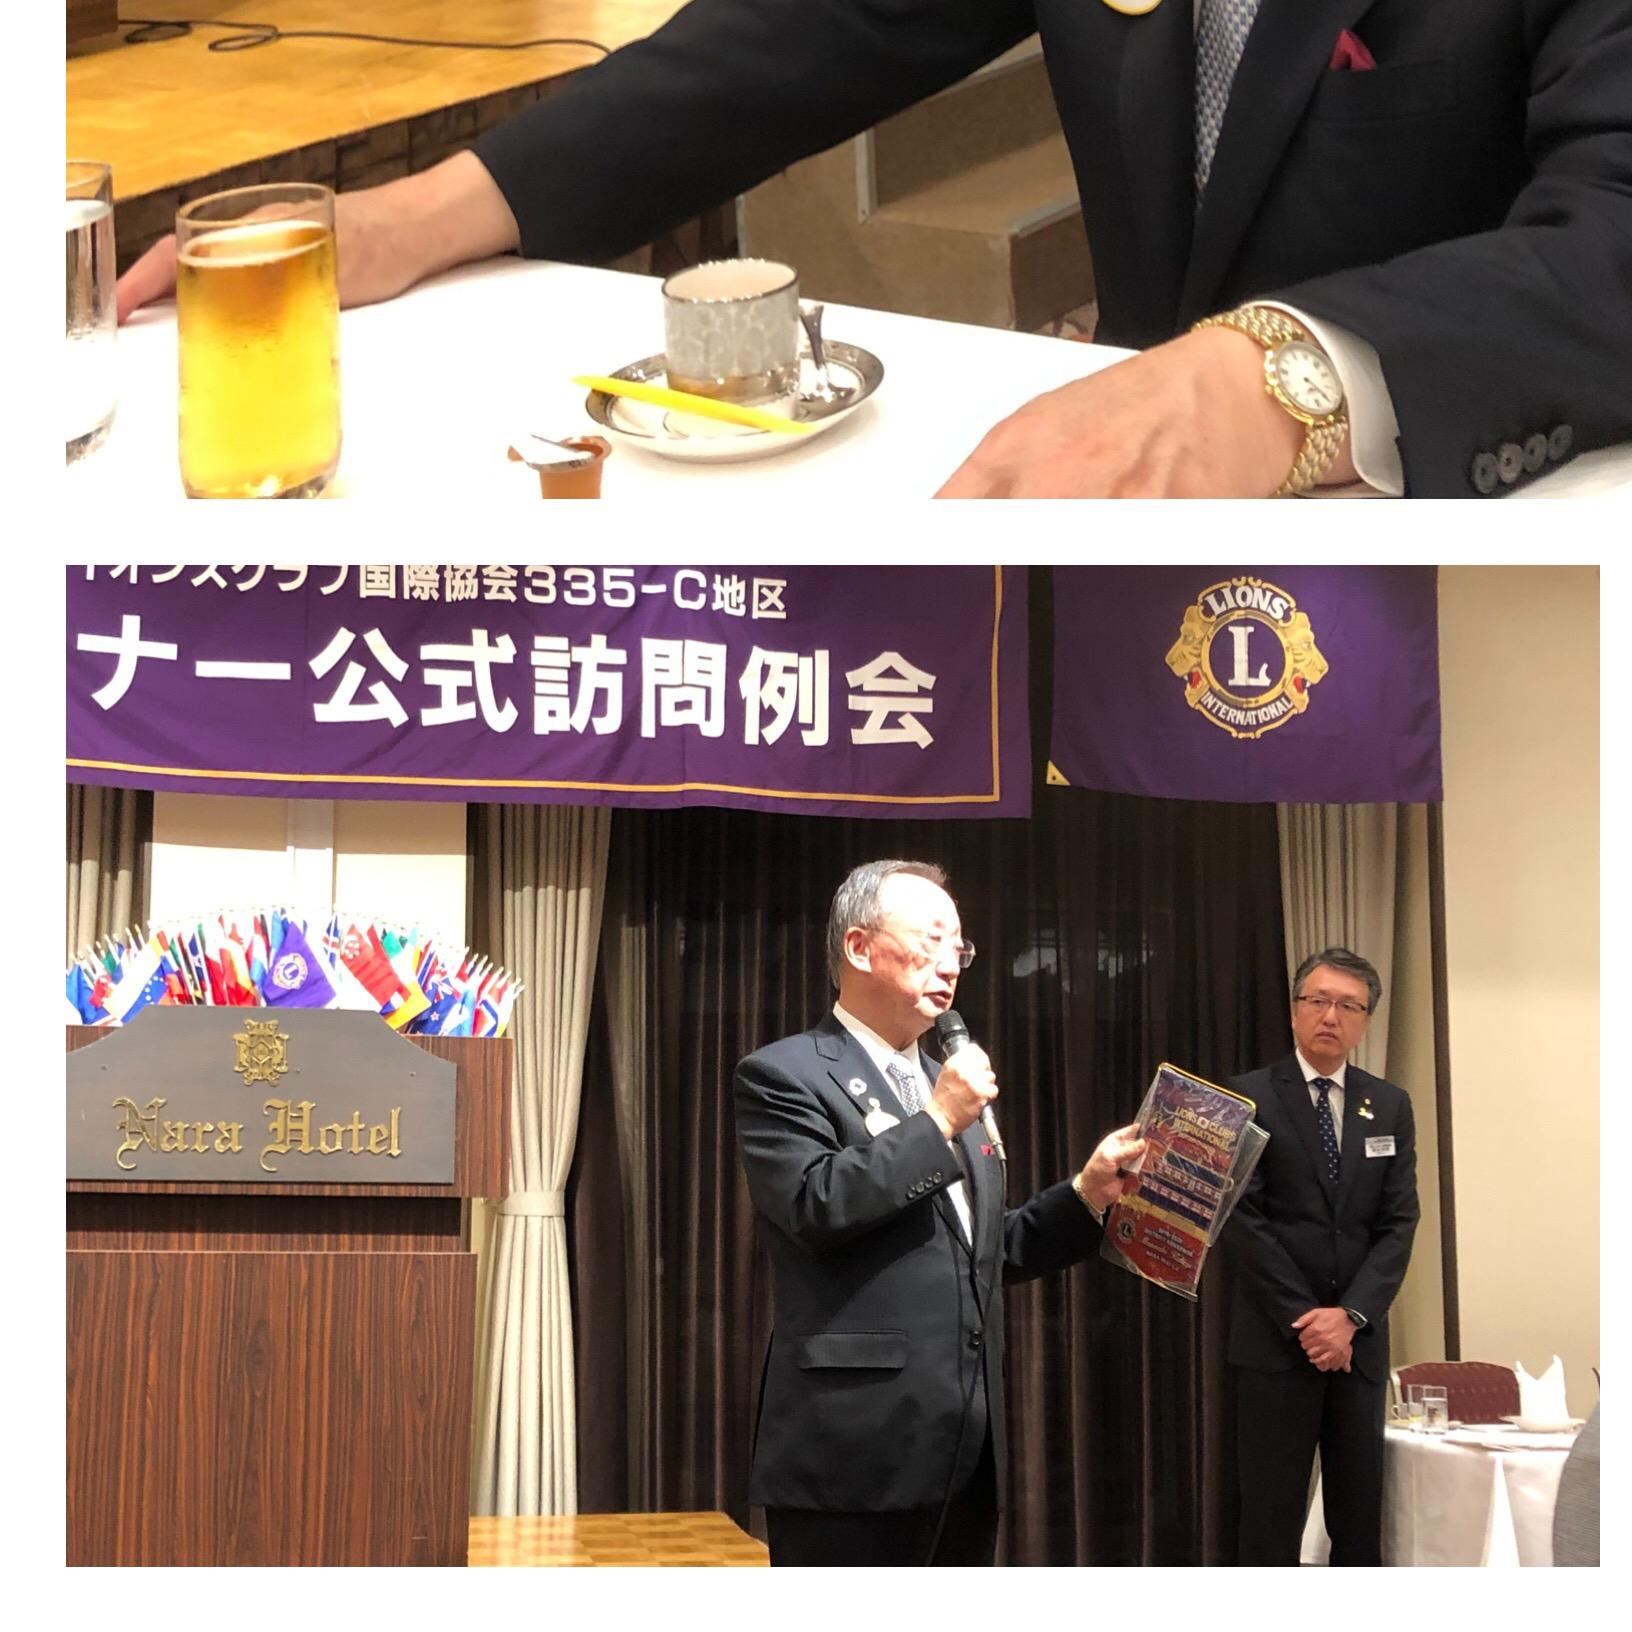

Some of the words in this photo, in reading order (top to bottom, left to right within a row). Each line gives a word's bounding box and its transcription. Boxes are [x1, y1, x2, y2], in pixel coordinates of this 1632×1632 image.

[1206, 586, 1288, 620] LIONS
[76, 614, 937, 749] ナー公式訪問例会
[1228, 626, 1271, 687] L
[1201, 691, 1293, 726] INTERNATIONAL
[112, 1097, 243, 1169] Nara
[260, 1099, 402, 1171] Hotel
